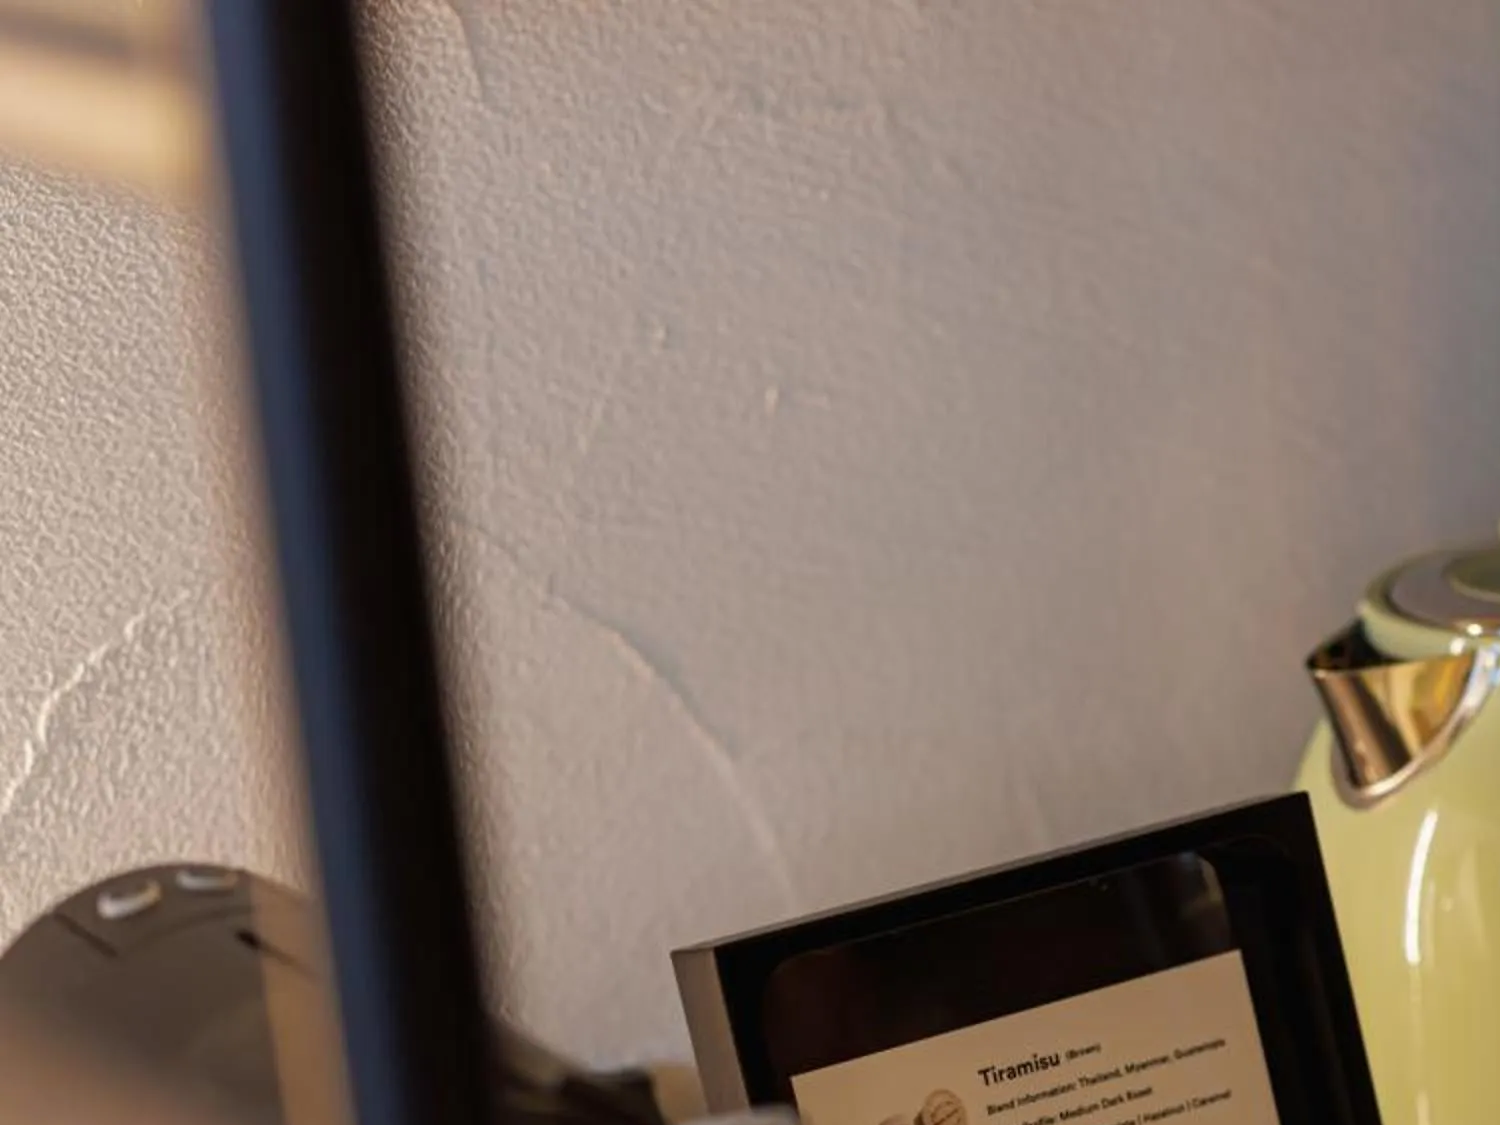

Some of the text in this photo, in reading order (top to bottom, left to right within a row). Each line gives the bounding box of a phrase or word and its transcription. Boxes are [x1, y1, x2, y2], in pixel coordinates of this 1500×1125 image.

[978, 1053, 1061, 1087] Tiramisu
[986, 1099, 1015, 1115] Blend
[1016, 1082, 1076, 1106] Information:
[1077, 1068, 1123, 1087] Thailand,
[1124, 1055, 1170, 1073] Myanmar,
[1059, 1103, 1099, 1120] Medium
[1100, 1094, 1124, 1109] Dark
[1125, 1087, 1152, 1100] Roast
[1142, 1104, 1185, 1122] Hazelnut
[1191, 1089, 1231, 1108] Caramel
